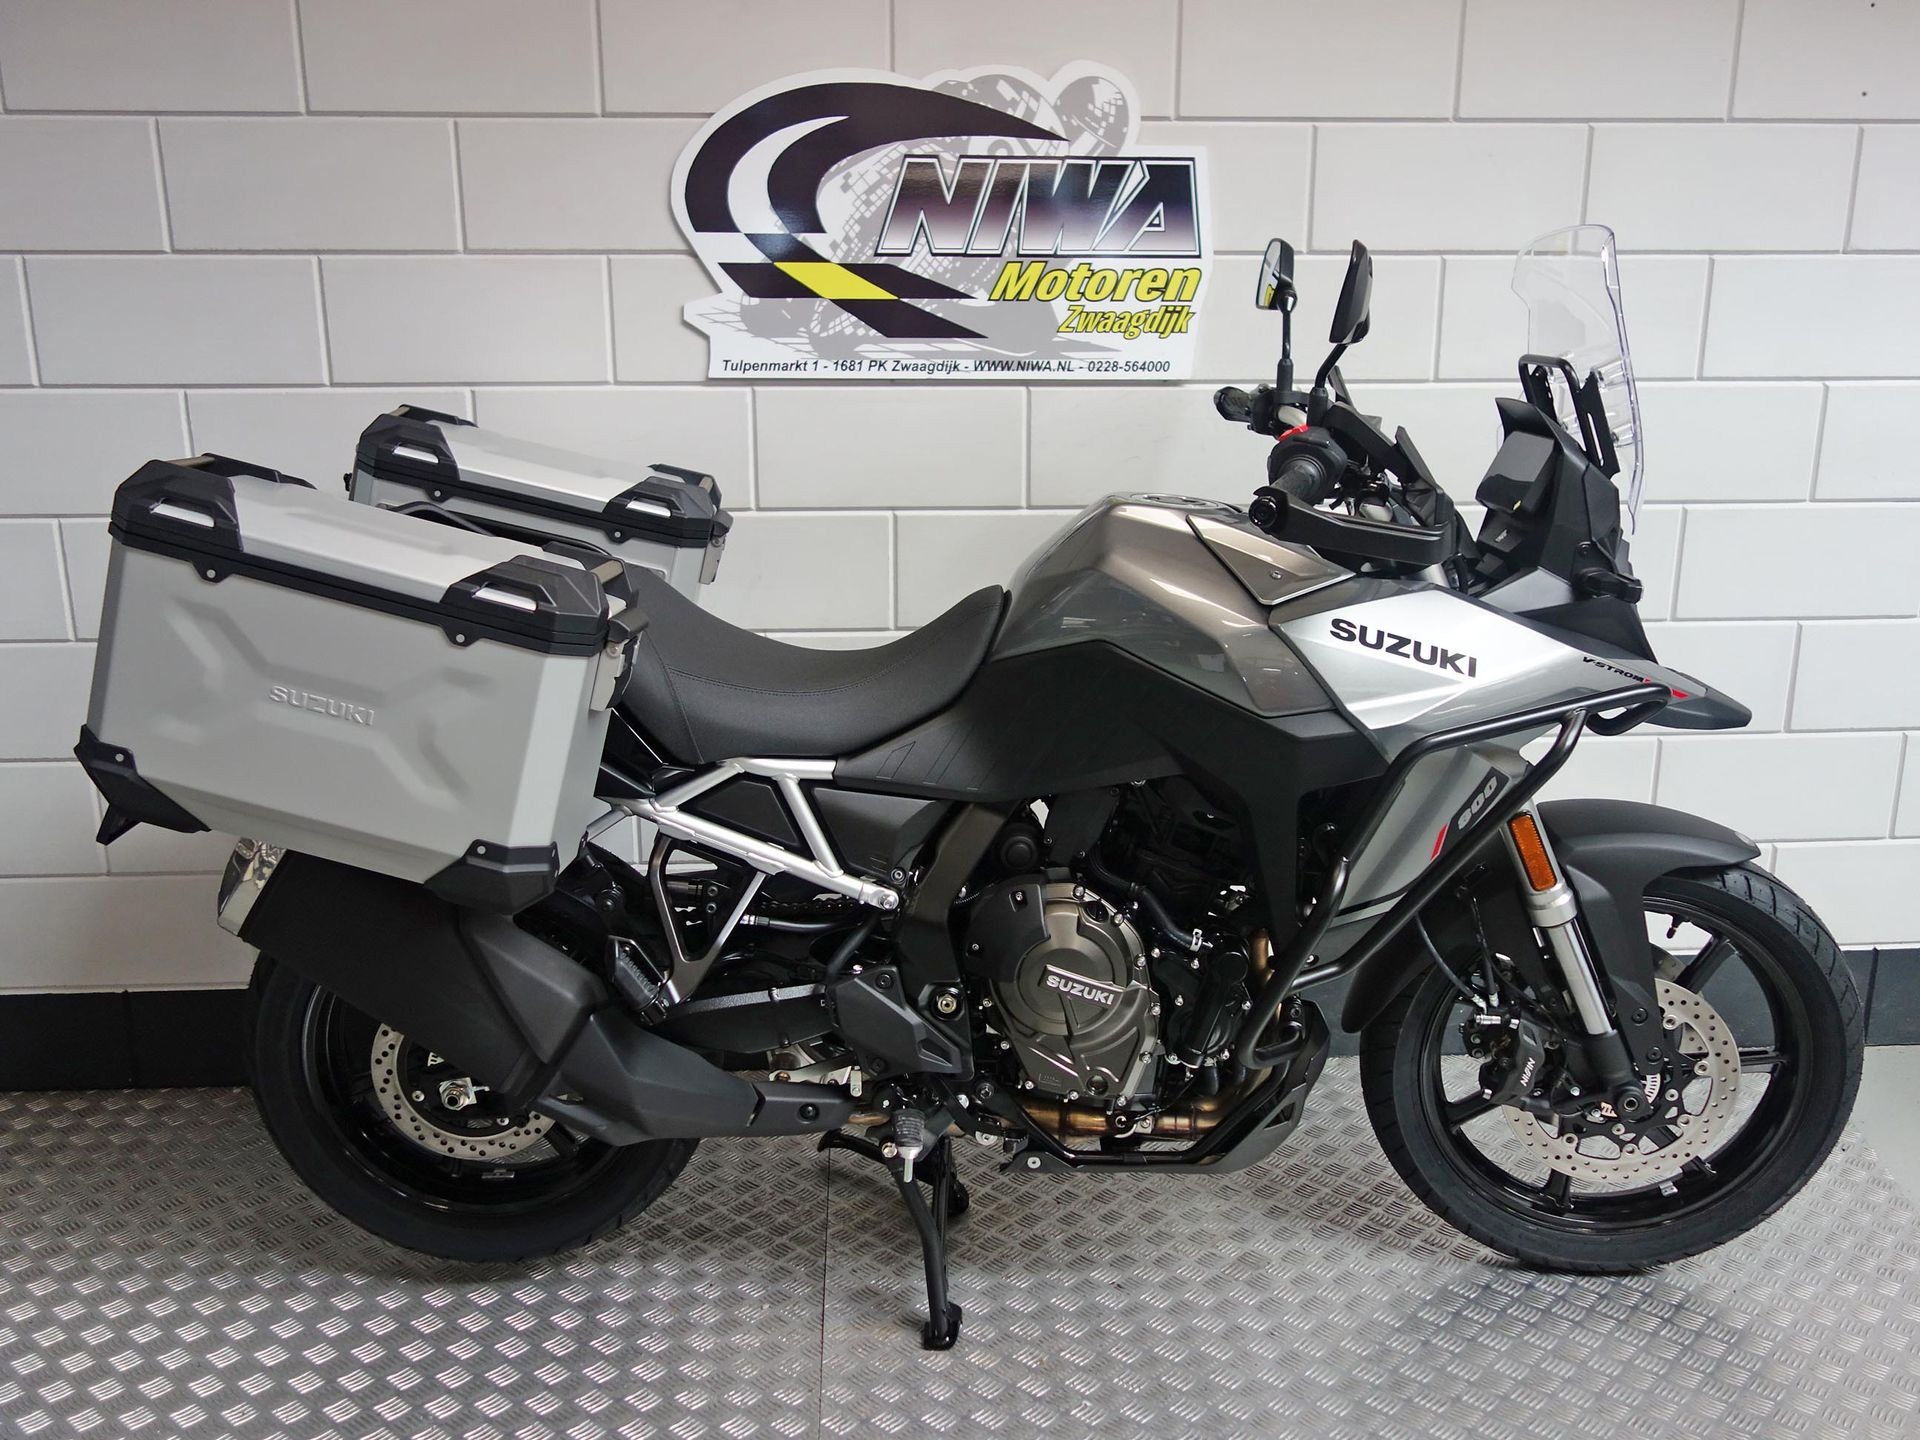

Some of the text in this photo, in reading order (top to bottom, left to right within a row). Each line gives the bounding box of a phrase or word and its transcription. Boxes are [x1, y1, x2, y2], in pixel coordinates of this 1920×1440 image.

[874, 154, 1202, 258] NIWA
[988, 261, 1202, 302] Motoren
[1057, 304, 1196, 340] Zwaagdijk
[722, 359, 808, 374] Tulpenmarkt
[812, 360, 819, 371] 1
[833, 360, 863, 372] 1681
[868, 360, 888, 371] PK
[892, 360, 960, 375] Zwaagdijk
[973, 360, 1075, 372] WWW.NIWA.NL
[1087, 360, 1171, 372] 0228-564000
[1330, 617, 1477, 678] SUZUKI
[269, 685, 374, 726] SUZUKI
[1457, 776, 1498, 830] 800
[1046, 974, 1114, 1005] SUZUKI
